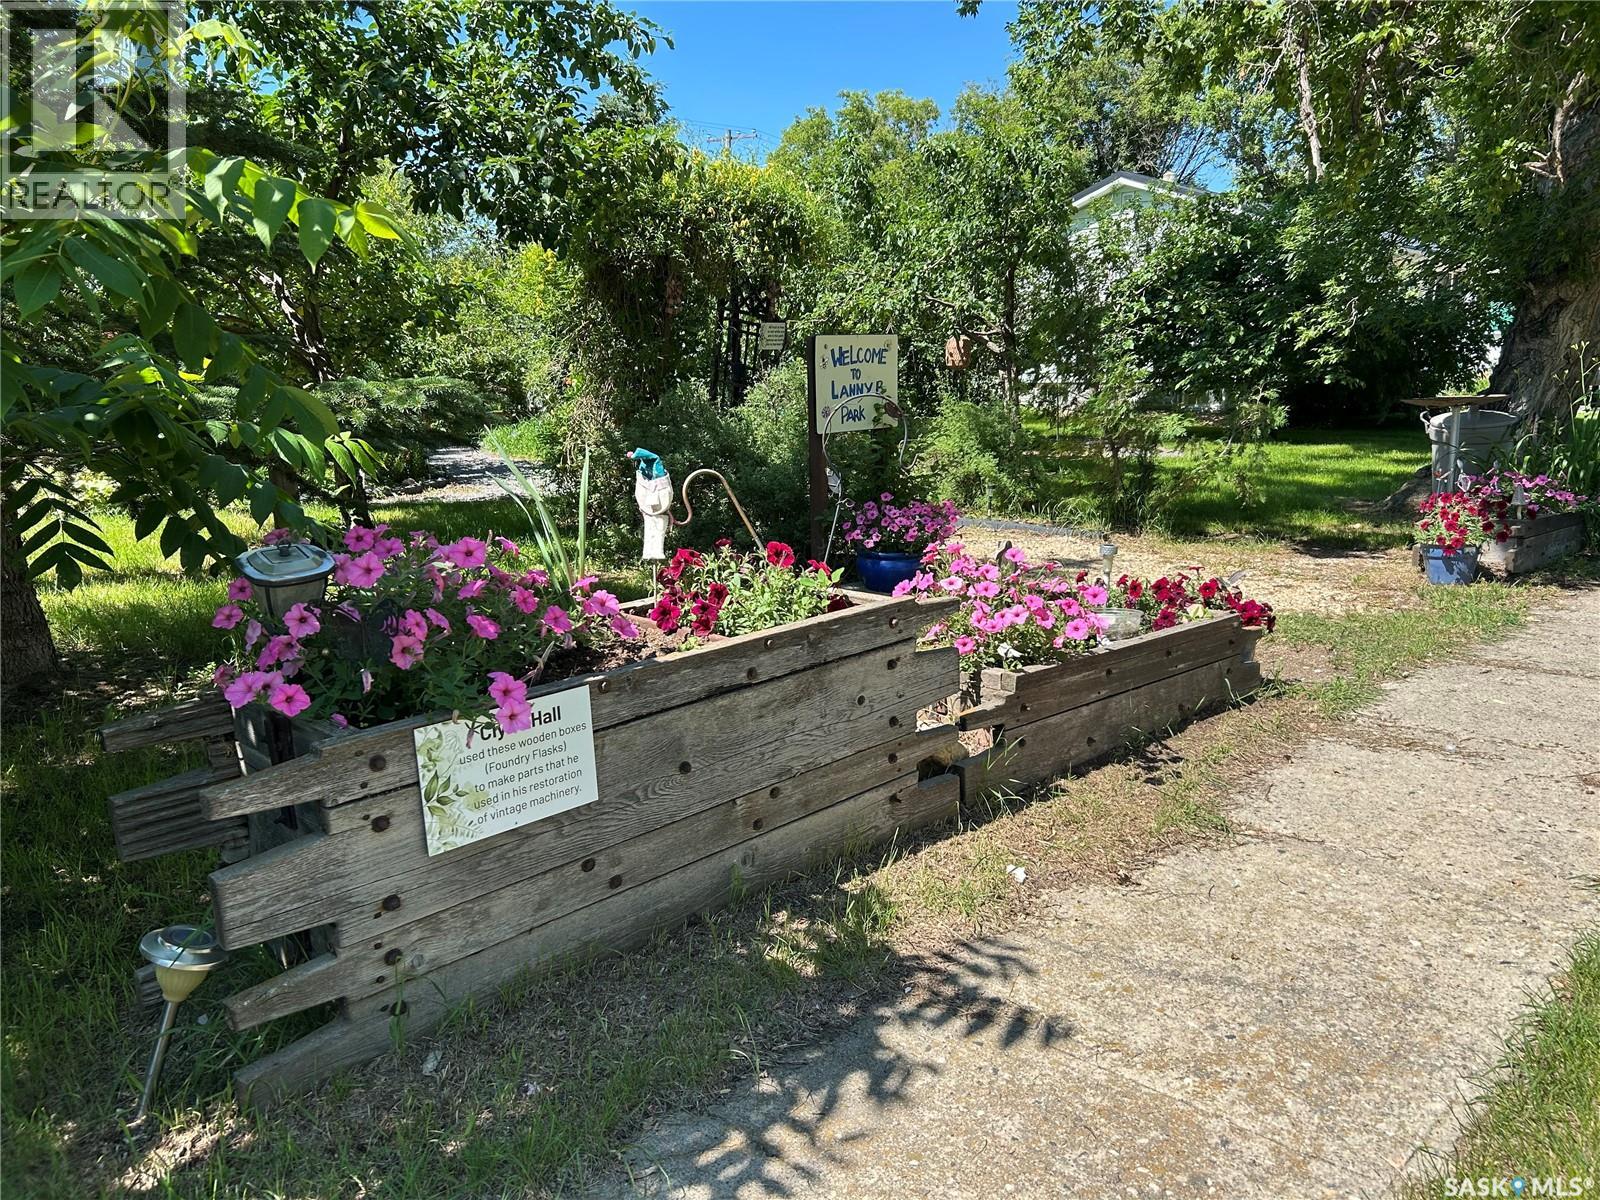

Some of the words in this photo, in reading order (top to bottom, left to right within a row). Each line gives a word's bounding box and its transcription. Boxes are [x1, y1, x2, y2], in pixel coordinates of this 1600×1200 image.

[830, 345, 888, 367] WELCOME
[850, 368, 862, 380] TO
[831, 380, 873, 400] LANNY
[841, 405, 865, 424] PARK
[531, 705, 561, 728] Hall
[459, 750, 485, 765] used
[487, 743, 516, 757] these
[518, 731, 557, 747] wooden
[559, 722, 587, 737] boxes
[484, 754, 530, 775] (Foundry
[532, 741, 567, 760] Flasks)
[474, 783, 486, 793] to
[488, 774, 516, 788] make
[518, 765, 544, 782] parts
[546, 758, 565, 771] that
[567, 755, 579, 765] he
[474, 795, 499, 810] used
[501, 791, 511, 801] in
[512, 785, 527, 798] his
[529, 768, 582, 793] restoration
[477, 814, 489, 825] of
[490, 803, 528, 820] vintage
[529, 785, 582, 808] machinery.
